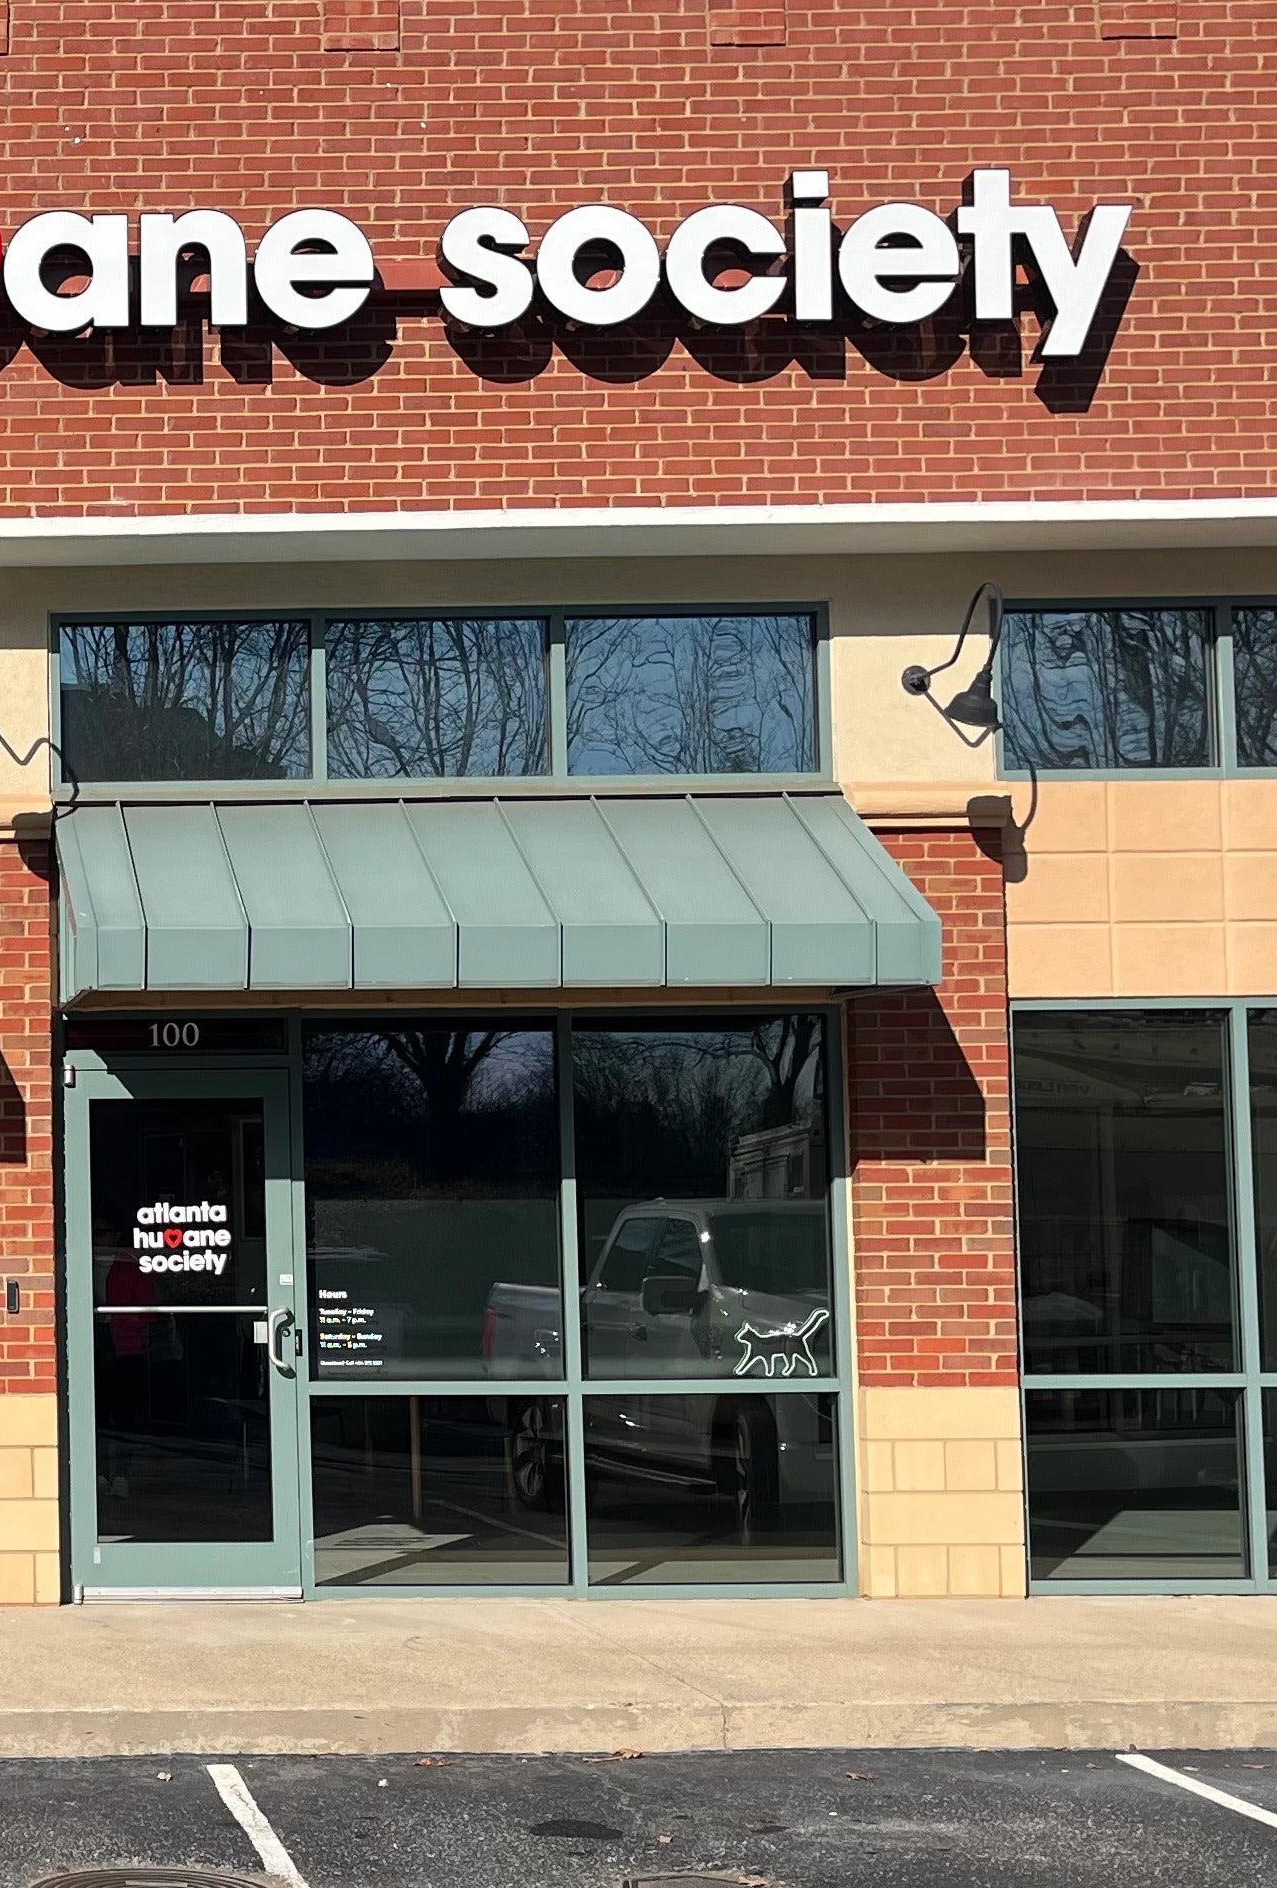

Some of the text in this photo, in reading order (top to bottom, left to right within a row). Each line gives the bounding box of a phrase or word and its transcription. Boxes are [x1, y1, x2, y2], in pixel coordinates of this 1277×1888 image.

[439, 168, 1133, 358] society
[148, 1022, 200, 1047] 100
[136, 1200, 227, 1224] atlanta
[138, 1249, 227, 1275] society
[318, 1289, 348, 1299] Hours
[318, 1308, 347, 1316] Tuesday
[352, 1308, 375, 1316] Friday
[319, 1332, 351, 1341] Saturday
[356, 1332, 383, 1342] Sunday
